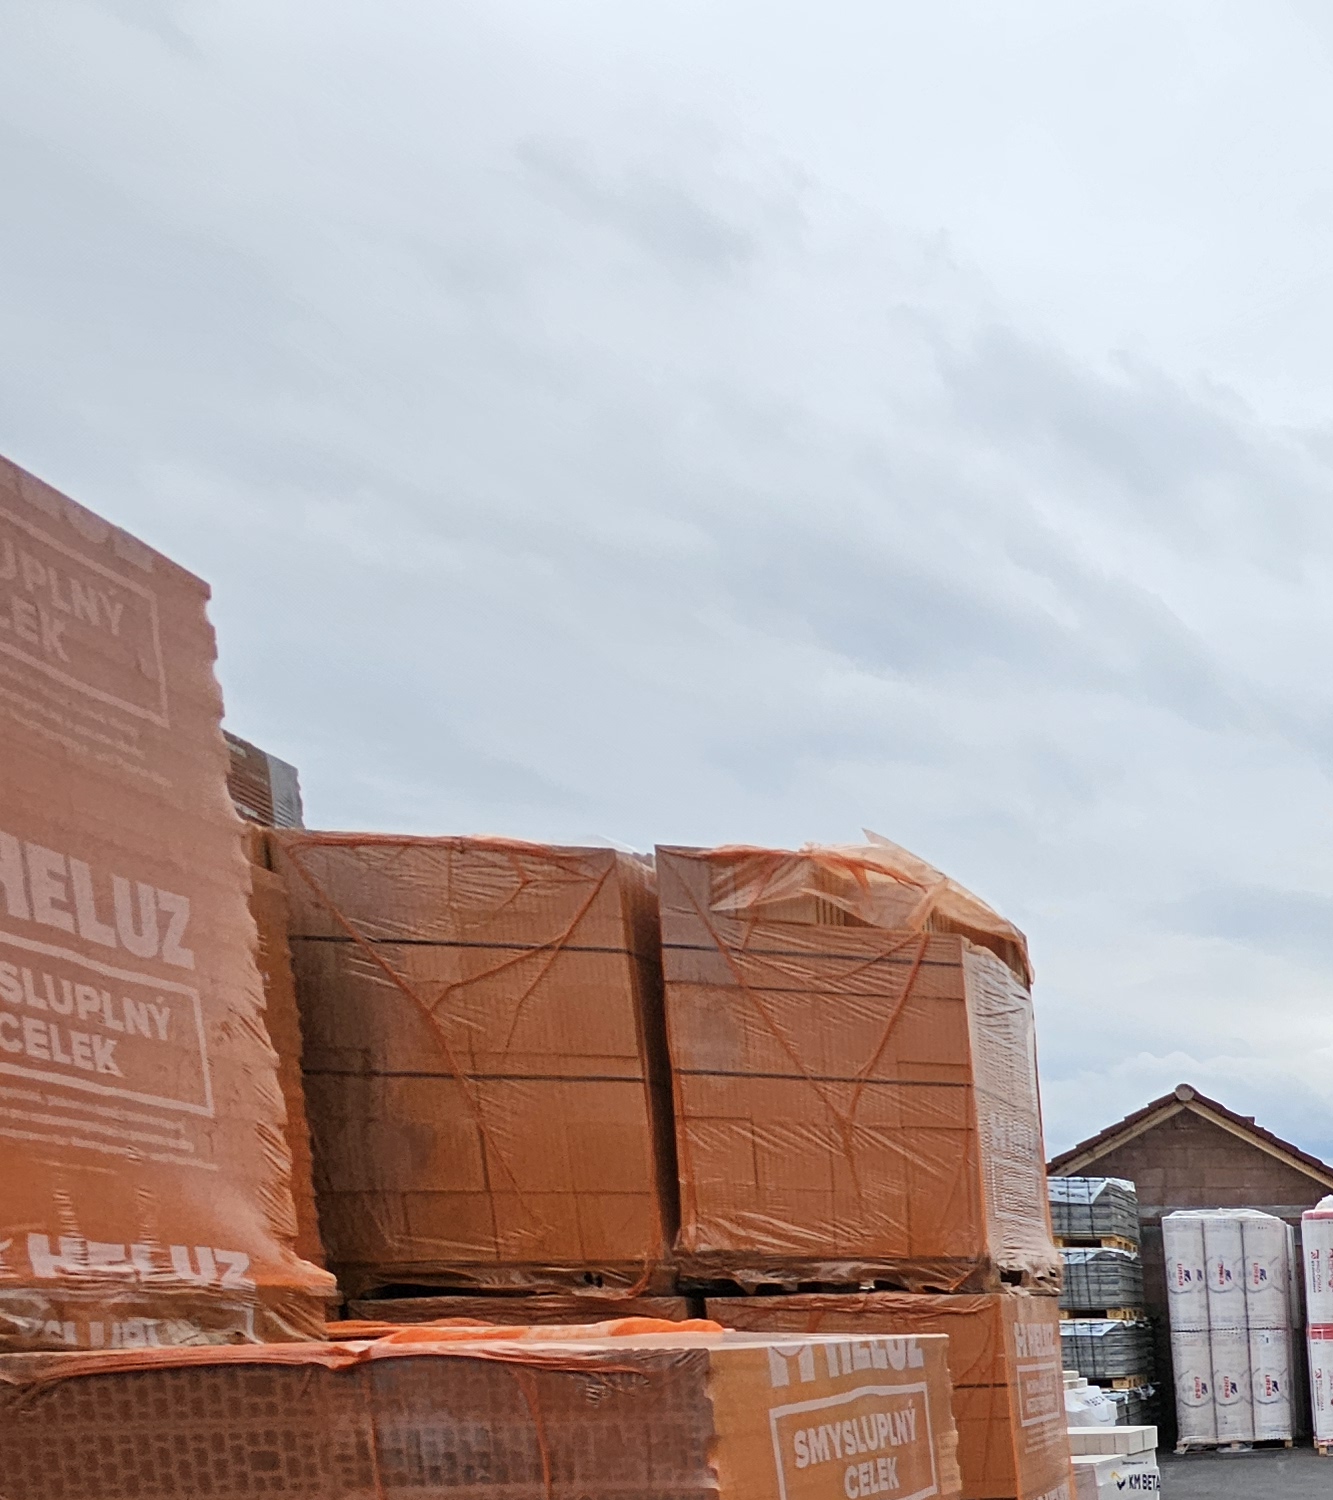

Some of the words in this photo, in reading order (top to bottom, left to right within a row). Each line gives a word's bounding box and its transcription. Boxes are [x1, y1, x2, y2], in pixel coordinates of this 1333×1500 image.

[28, 1232, 256, 1290] HELUZ
[794, 1399, 916, 1468] SMYSLUPLNÝ
[844, 1457, 900, 1499] CELEK
[1128, 1475, 1141, 1489] KM
